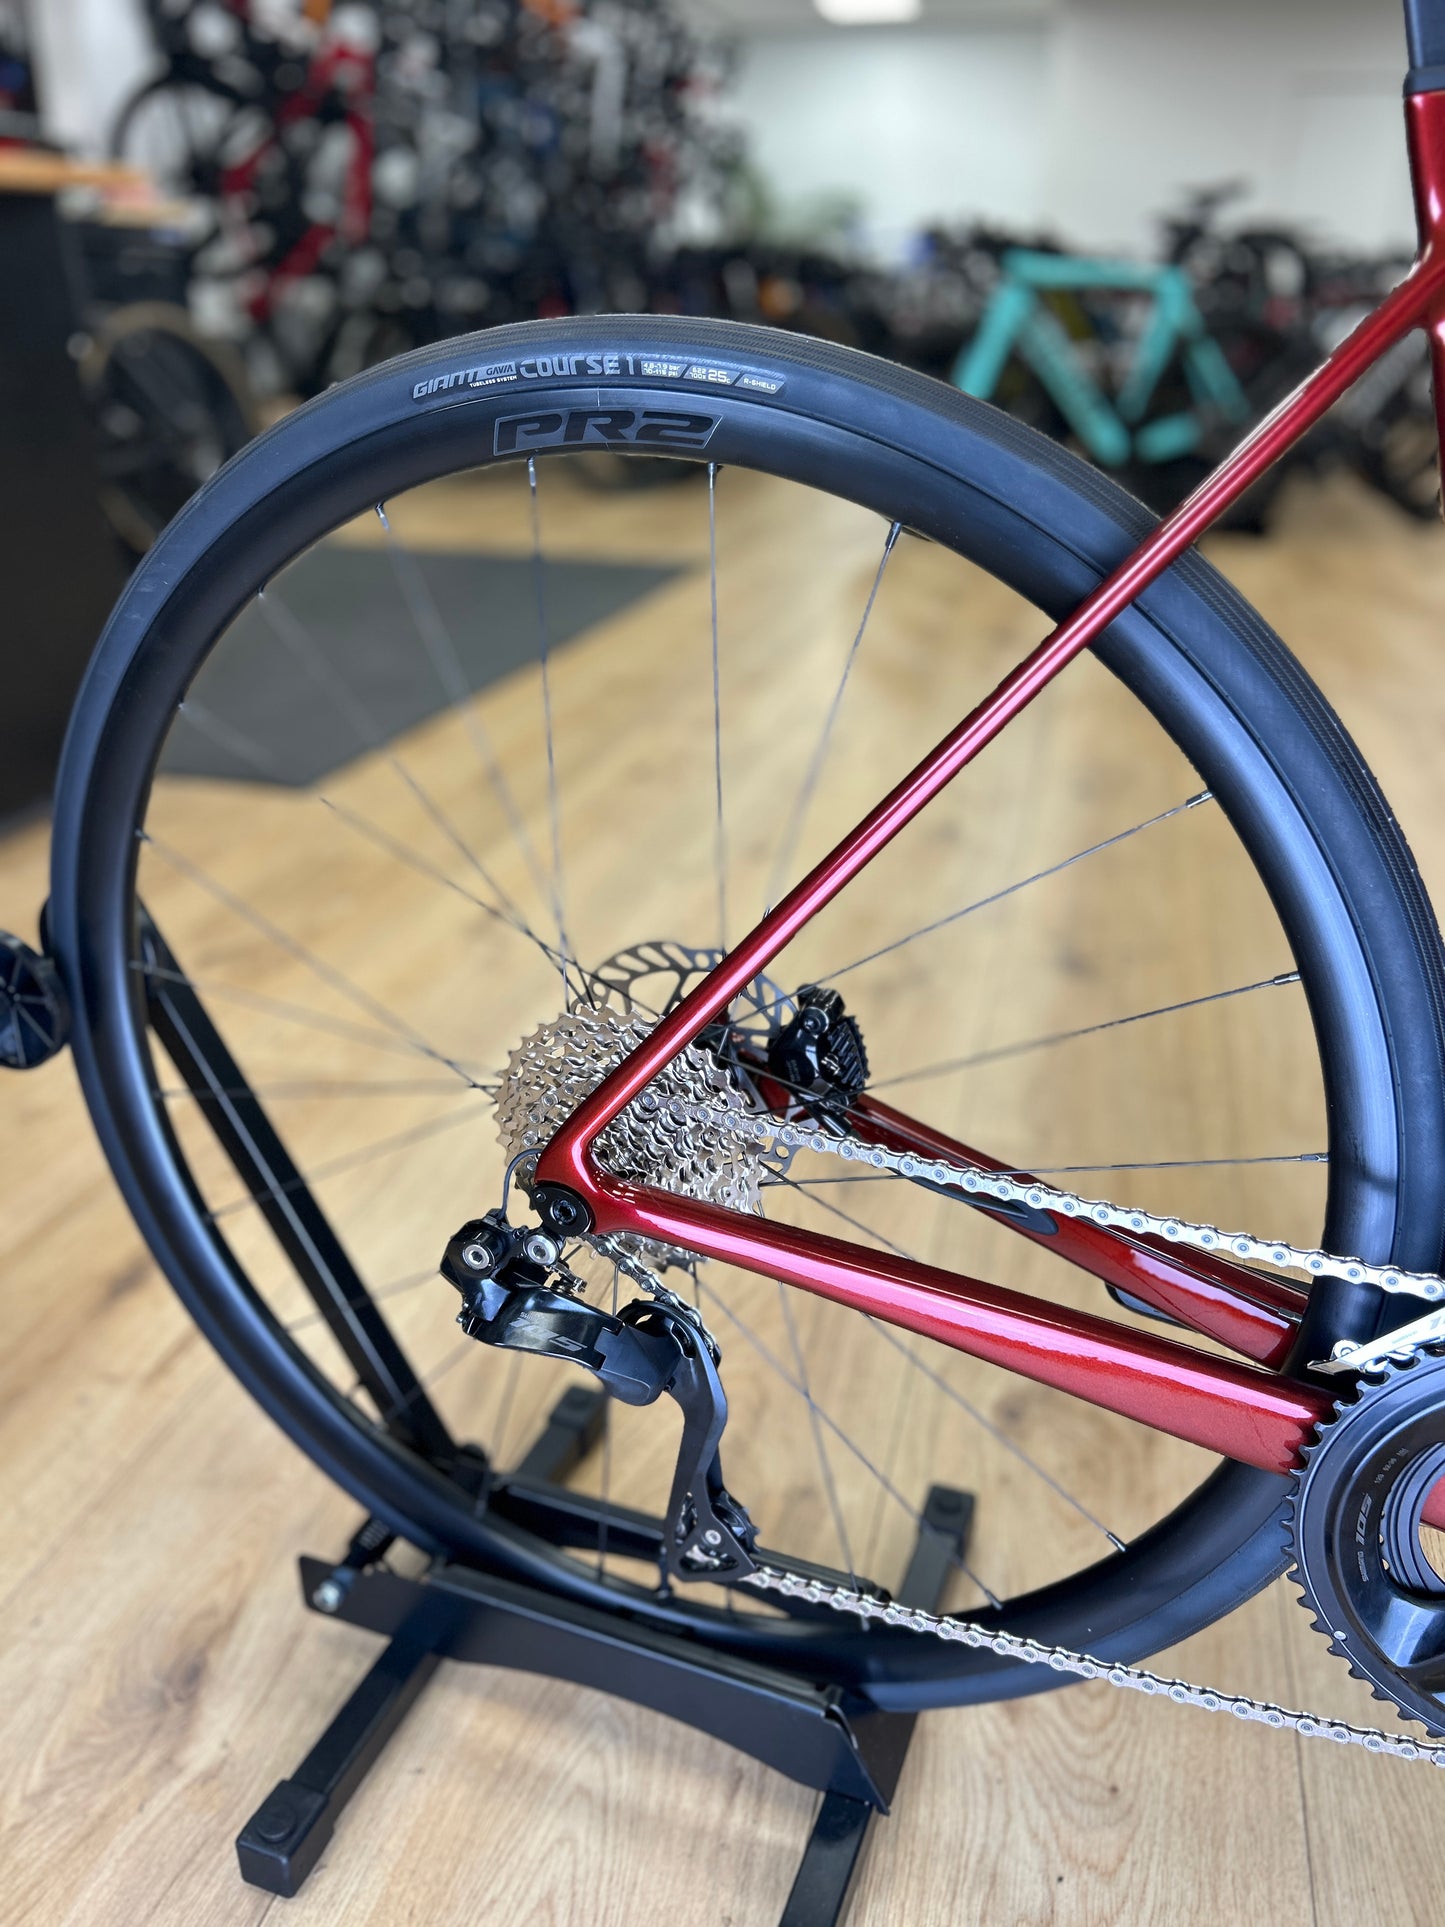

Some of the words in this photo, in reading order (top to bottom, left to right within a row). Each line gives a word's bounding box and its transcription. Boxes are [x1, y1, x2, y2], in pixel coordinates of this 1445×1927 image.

[413, 369, 478, 399] GIANT
[486, 364, 514, 376] GAVIA
[519, 355, 621, 379] COURSE
[626, 355, 635, 375] 1
[469, 379, 497, 388] TUBELESS
[496, 375, 518, 384] SYSTEM
[743, 378, 776, 391] R-SHIELD
[497, 410, 714, 451] PR2
[1355, 1492, 1374, 1546] 105
